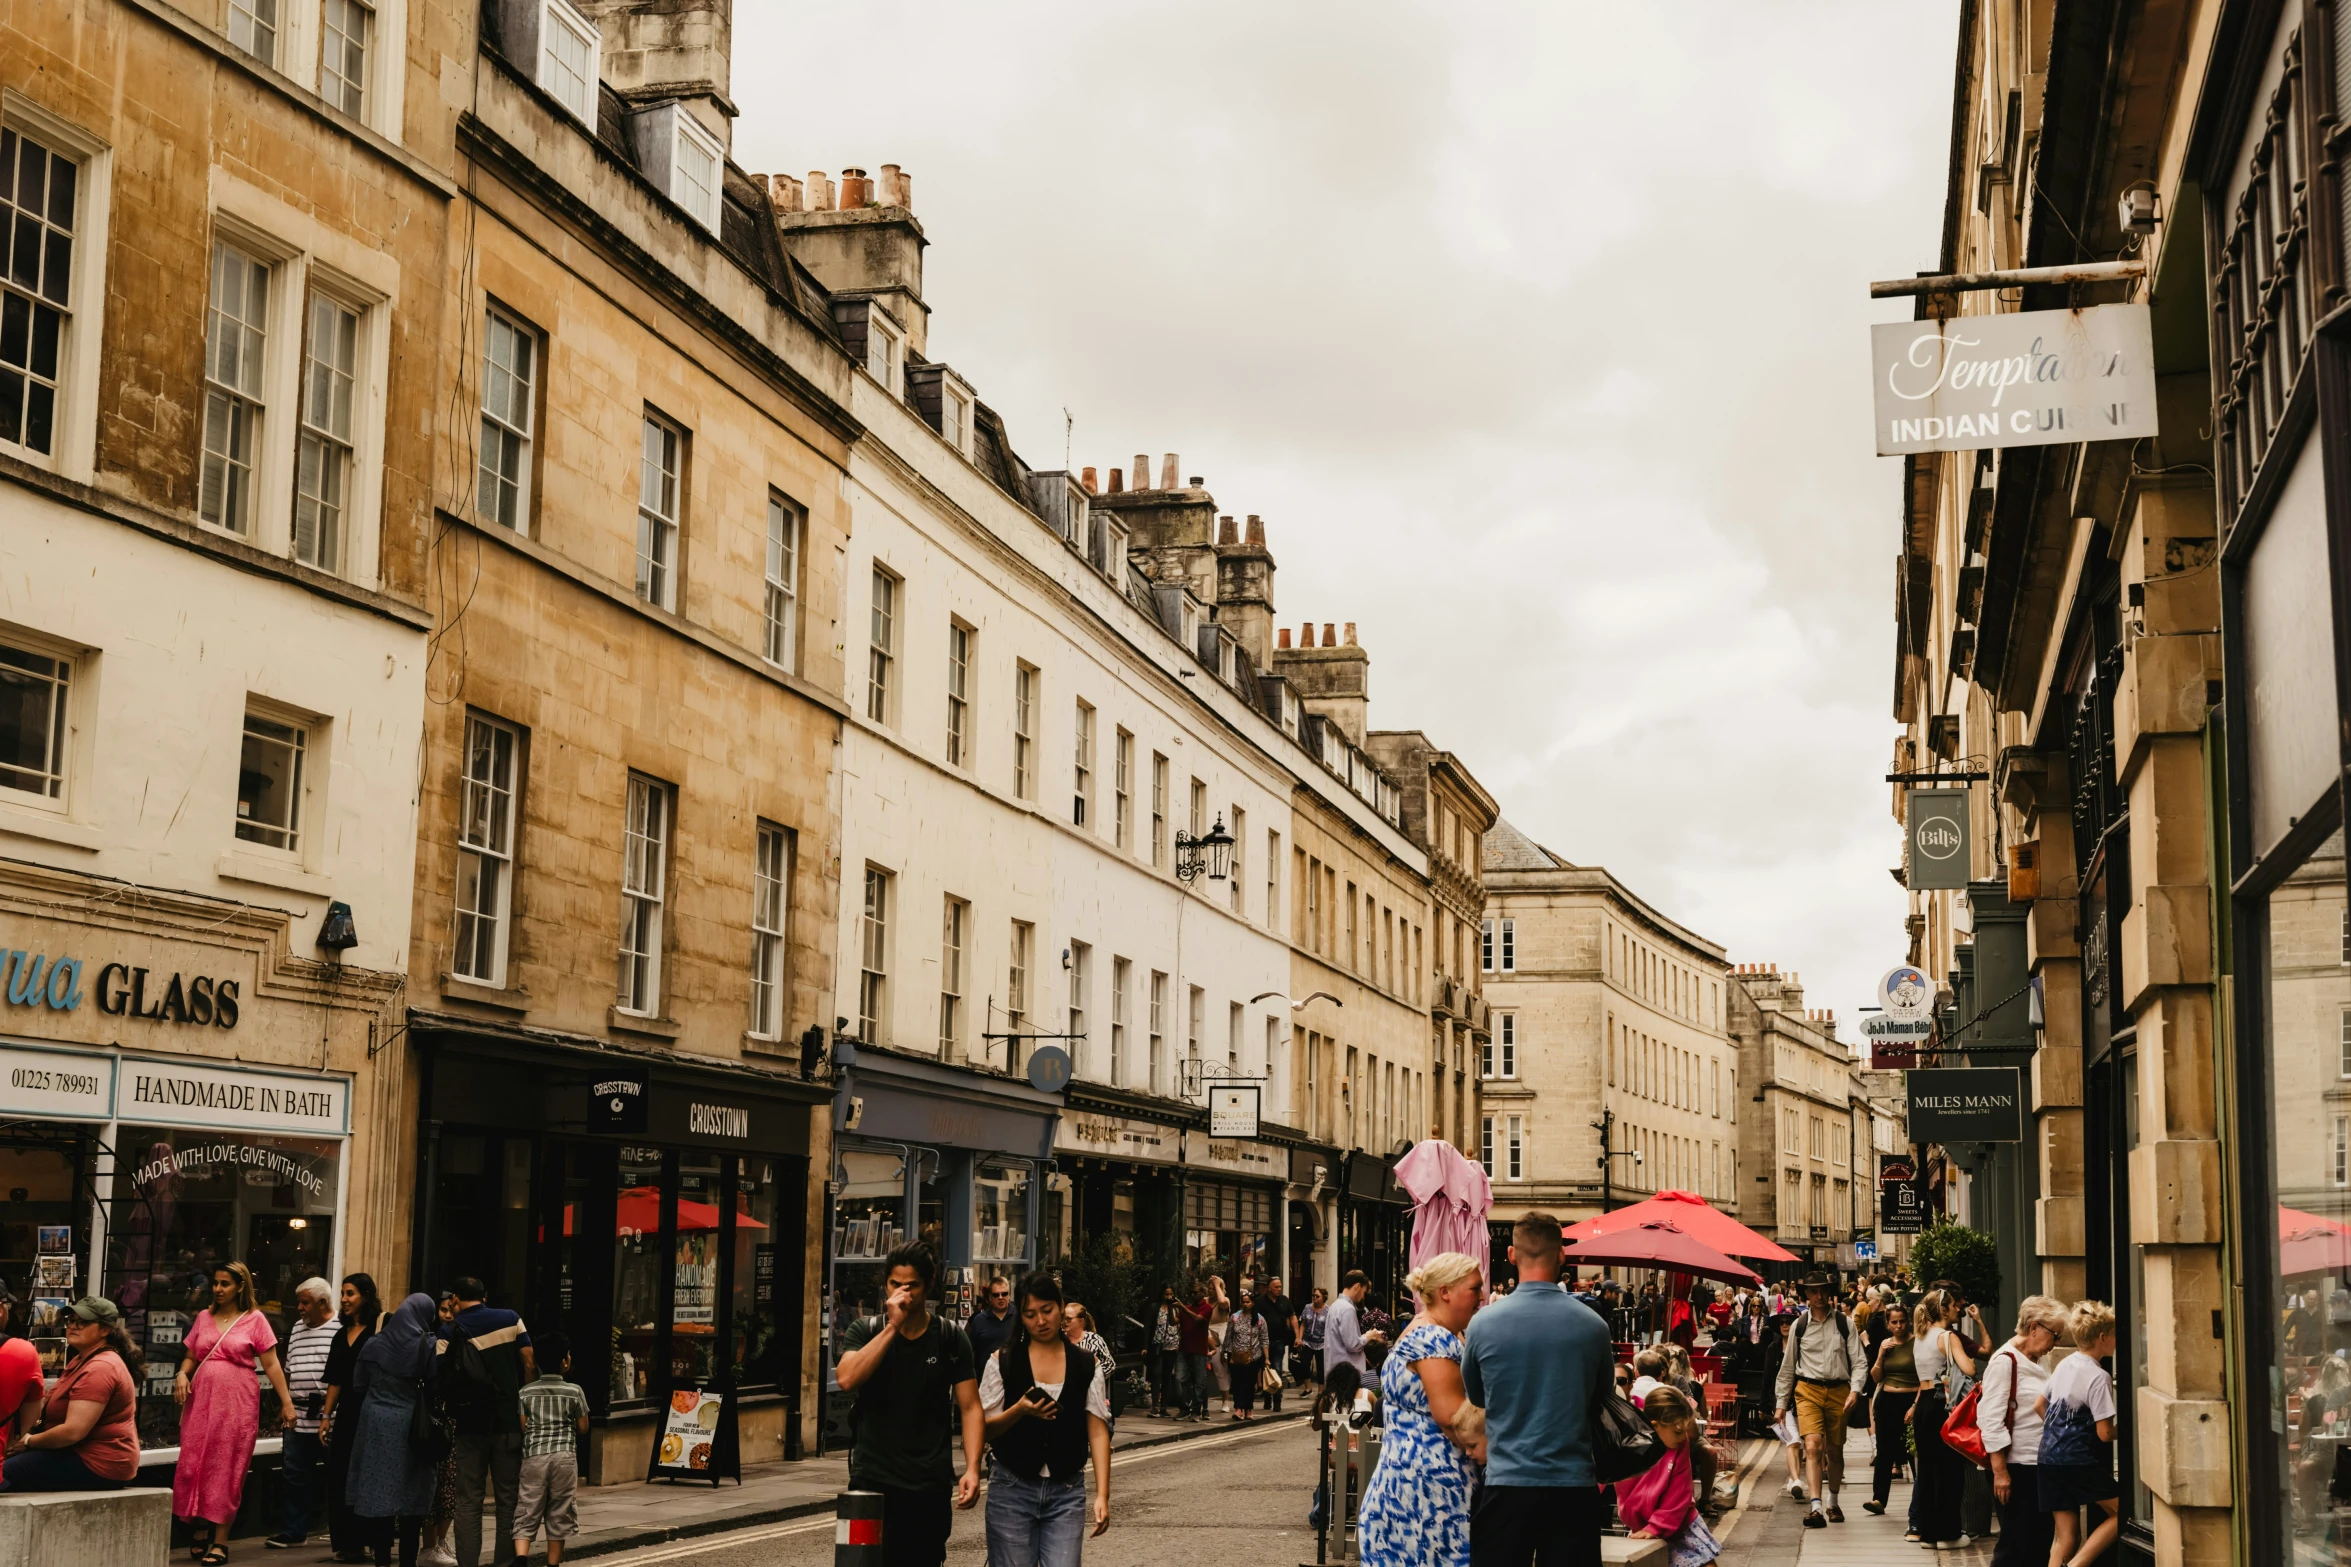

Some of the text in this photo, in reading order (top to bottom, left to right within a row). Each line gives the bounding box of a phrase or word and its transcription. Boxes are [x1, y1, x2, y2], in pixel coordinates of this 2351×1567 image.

[1891, 411, 2000, 444] INDIAN
[1920, 827, 1958, 848] Bill's
[97, 962, 240, 1029] GLASS
[1892, 1008, 1922, 1018] PAPAW
[1868, 1021, 1885, 1035] JoJo
[1887, 1021, 1913, 1034] Maman
[11, 1067, 98, 1096] 01225 789931
[593, 1080, 643, 1097] CROSSTOWN
[133, 1075, 332, 1118] HANDMADE IN BATH
[1915, 1095, 2011, 1108] MILES MANN
[689, 1102, 749, 1138] CROSSTOWN
[1212, 1111, 1256, 1121] SQUARE
[131, 1157, 170, 1189] MADE
[171, 1147, 204, 1171] WITH
[206, 1145, 239, 1165] LOVE,
[240, 1146, 267, 1167] GIVE
[267, 1151, 295, 1178] WITH
[295, 1165, 323, 1196] LOVE
[624, 1173, 637, 1185] COFFEE
[1490, 1227, 1511, 1237] STA
[675, 1263, 715, 1287] HANDMADE
[674, 1288, 690, 1304] FRESH
[669, 1427, 690, 1435] SEASONAL
